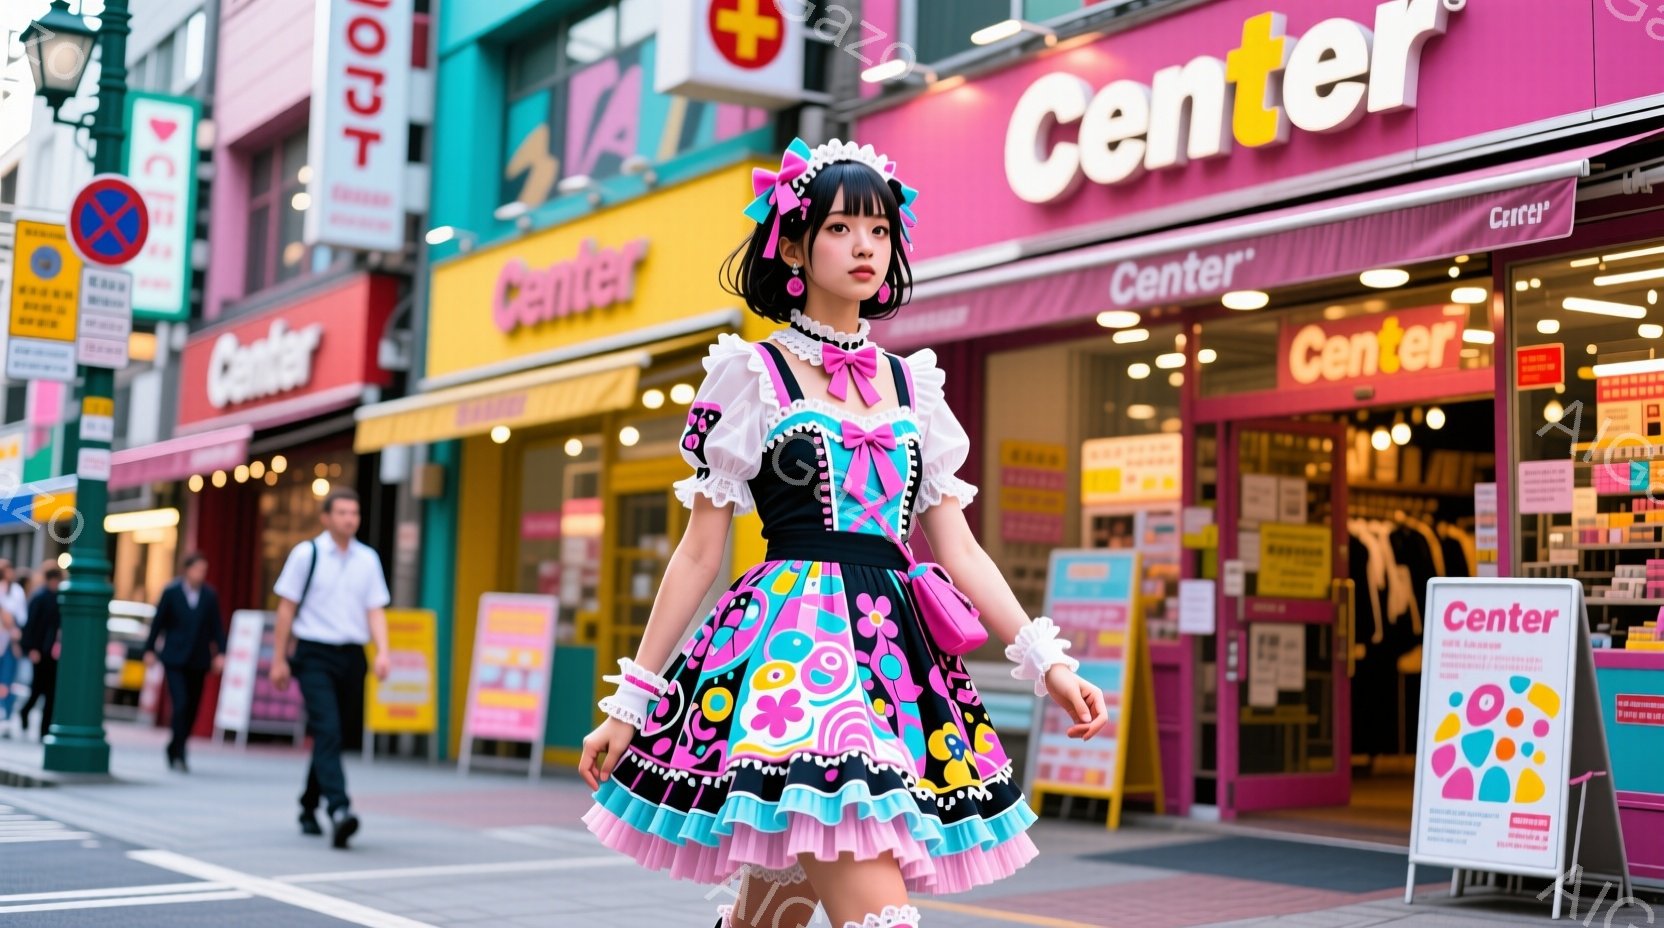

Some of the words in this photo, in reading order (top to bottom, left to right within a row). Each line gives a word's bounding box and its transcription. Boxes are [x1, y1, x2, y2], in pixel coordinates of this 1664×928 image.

[1004, 0, 1447, 204] Center
[494, 237, 649, 333] Center
[1110, 249, 1244, 305] Center
[1289, 316, 1457, 384] Center
[1443, 600, 1560, 635] Center
